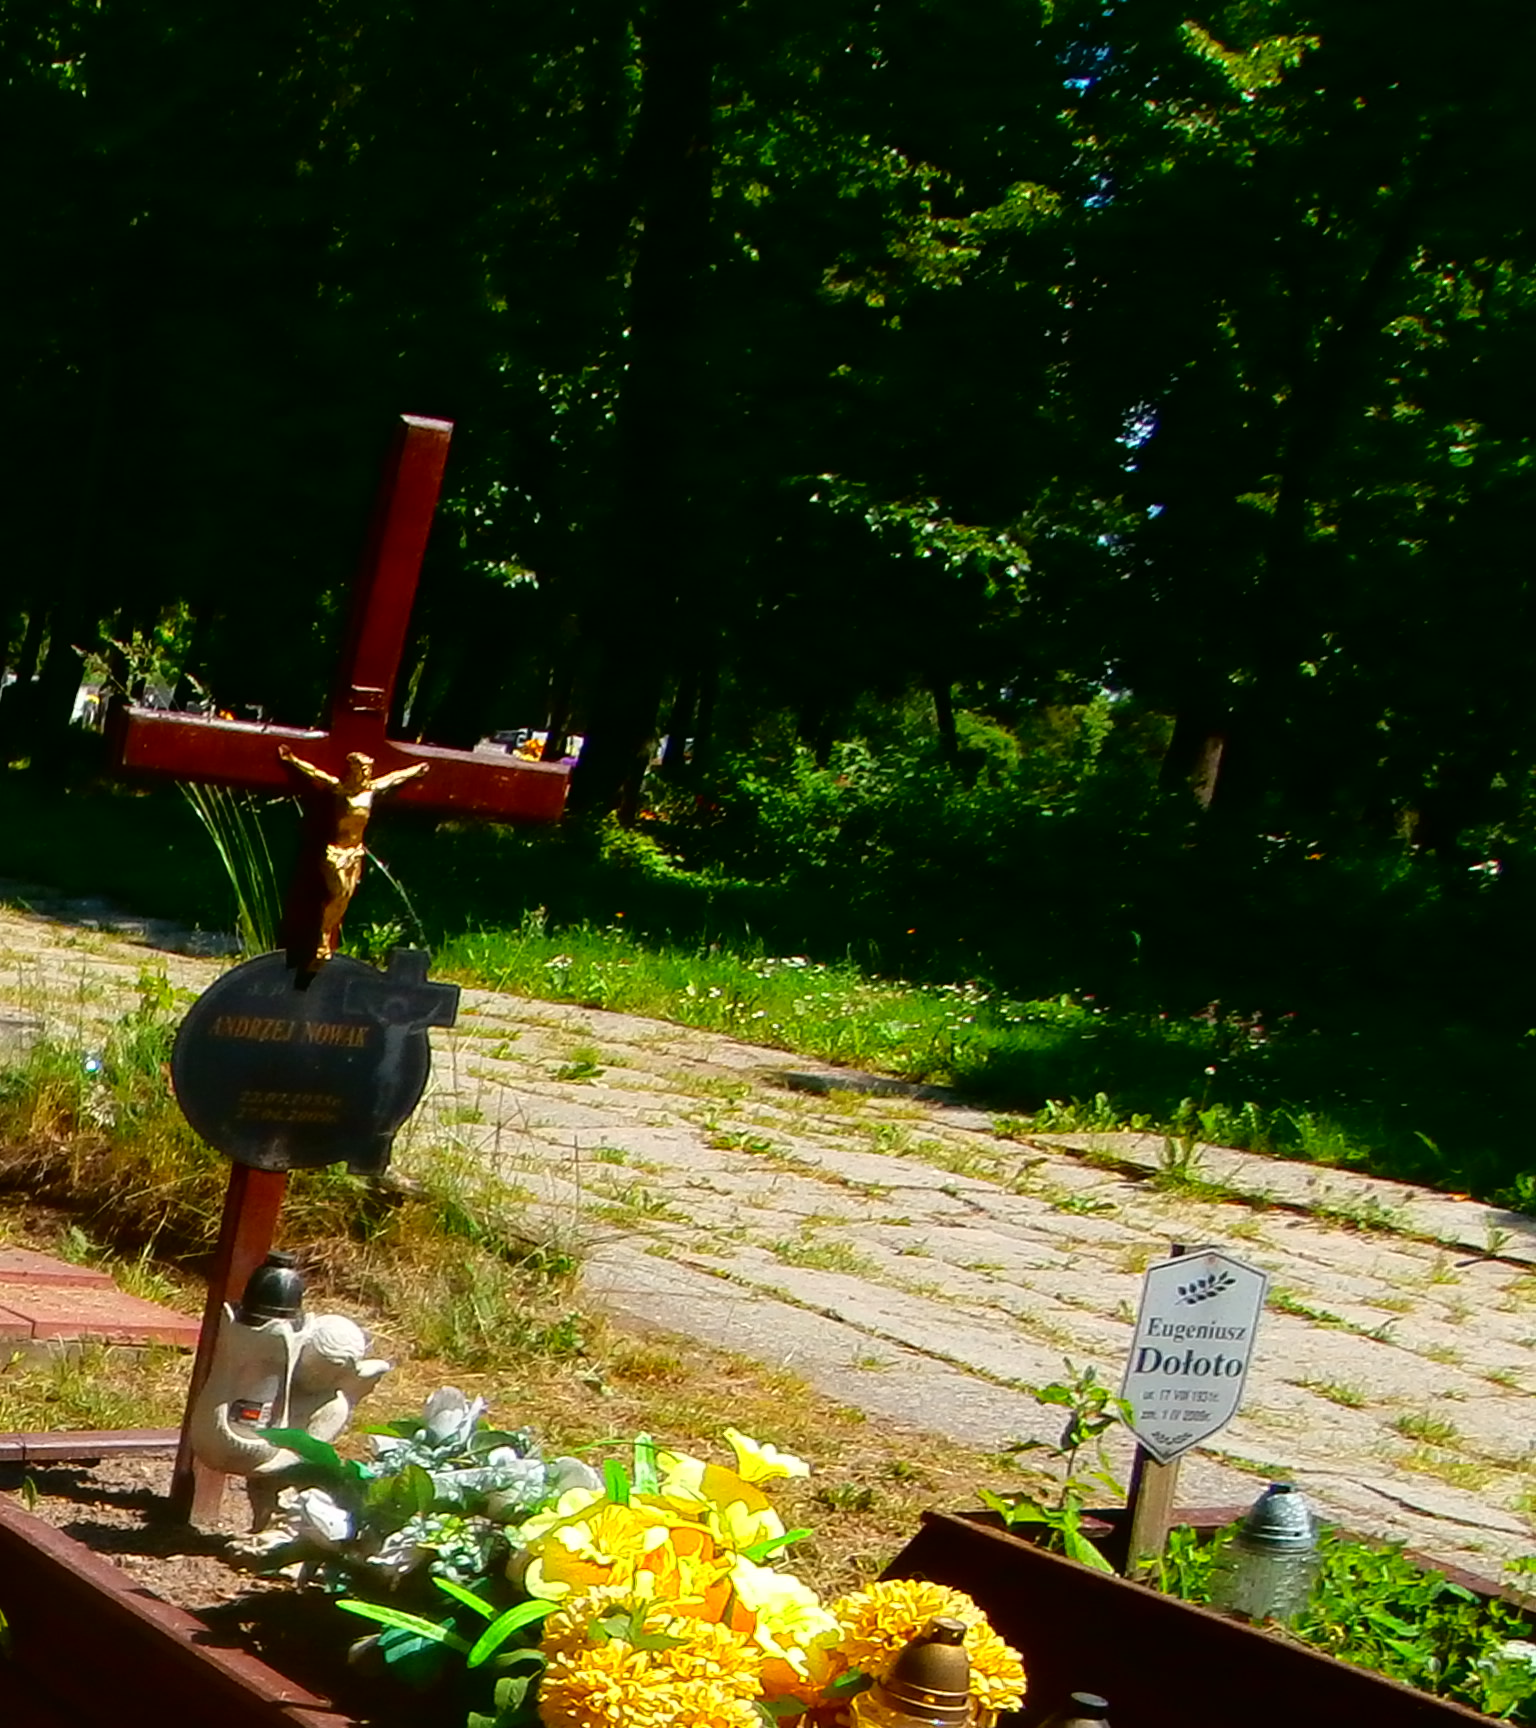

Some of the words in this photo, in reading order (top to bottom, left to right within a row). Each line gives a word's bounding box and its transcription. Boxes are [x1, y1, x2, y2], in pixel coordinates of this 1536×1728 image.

[208, 1014, 296, 1042] ANDRZEJ
[304, 1020, 370, 1048] NOWAK
[1147, 1317, 1246, 1342] Eugeniusz
[1134, 1346, 1243, 1378] Dołoto
